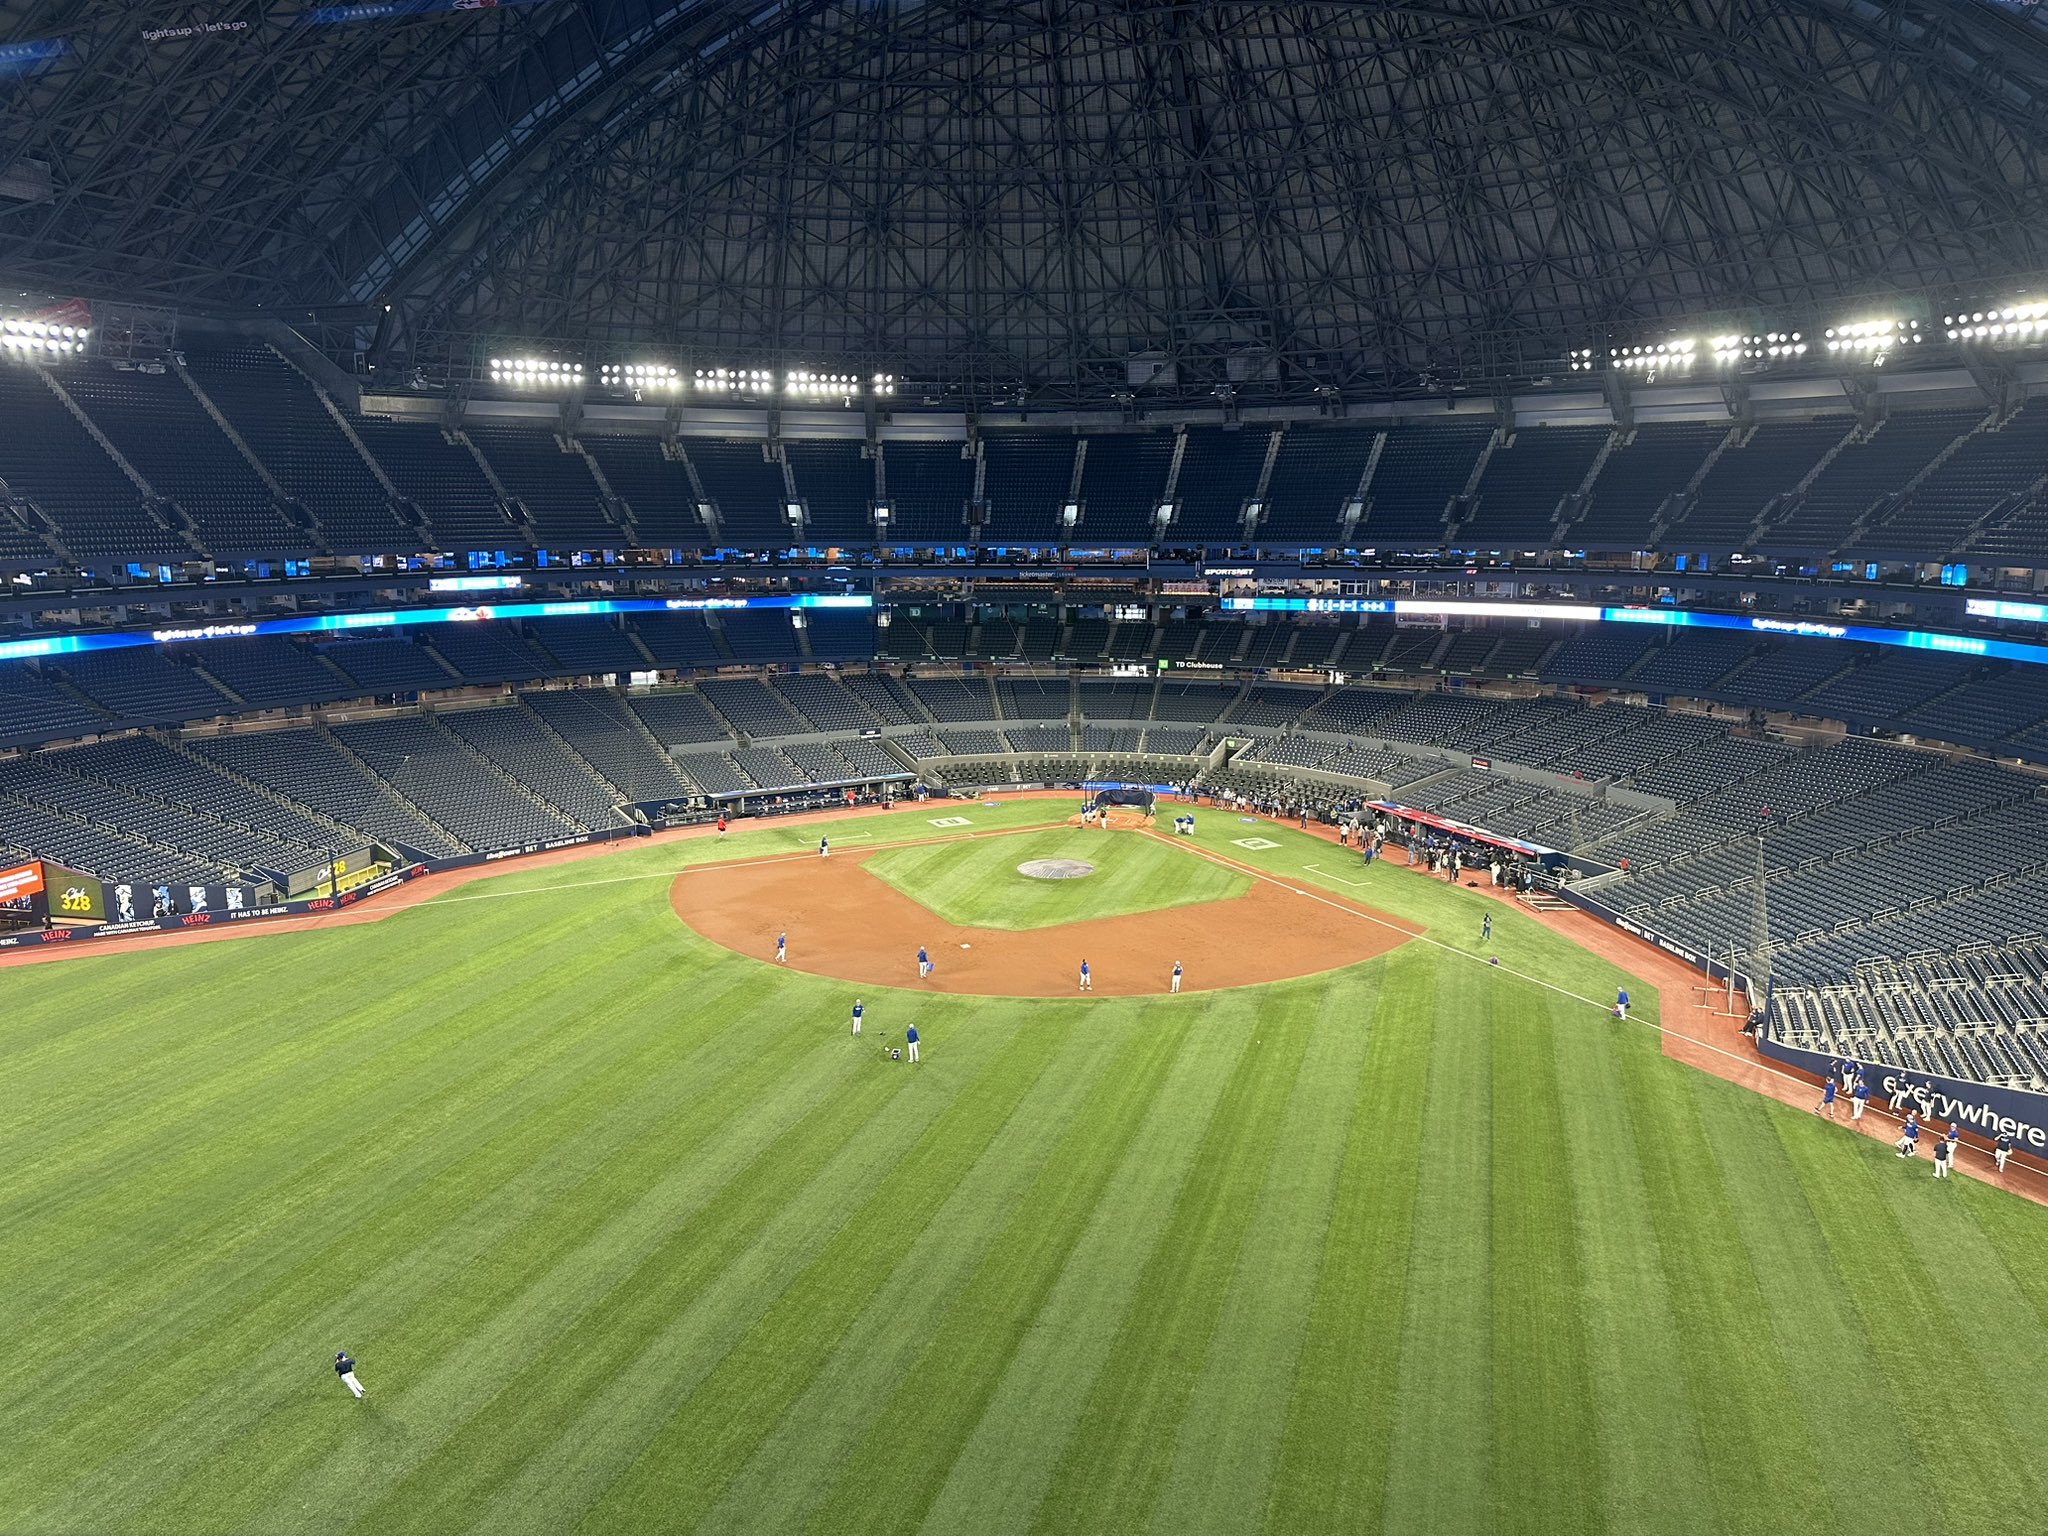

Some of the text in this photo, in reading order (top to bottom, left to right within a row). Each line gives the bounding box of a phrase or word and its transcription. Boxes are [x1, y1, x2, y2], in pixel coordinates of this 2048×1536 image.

[142, 21, 247, 41] lights up let's go
[1186, 661, 1223, 669] Clubhouse
[525, 845, 538, 853] BET
[545, 838, 575, 849] BASELINE
[61, 893, 91, 911] 328
[307, 900, 335, 910] HEINZ
[238, 910, 251, 918] HAS
[252, 909, 261, 917] TO
[262, 908, 269, 916] BE
[181, 914, 210, 925] HEINZ
[99, 922, 129, 932] CANADIAN
[41, 930, 72, 942] HEINZ
[1659, 938, 1697, 963] BASELINE BOX
